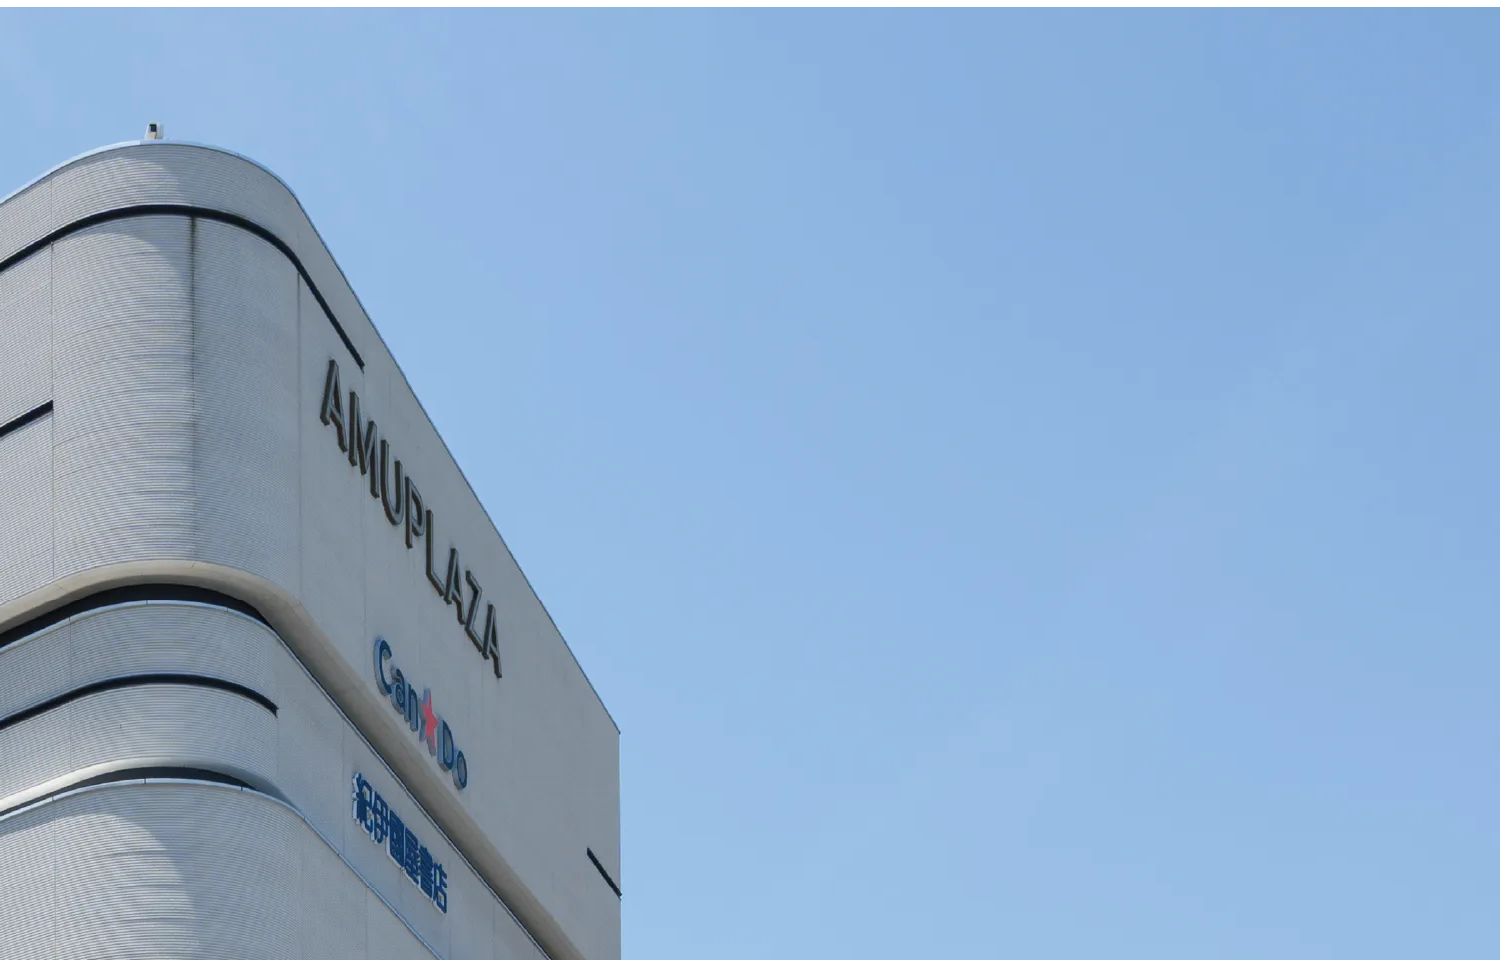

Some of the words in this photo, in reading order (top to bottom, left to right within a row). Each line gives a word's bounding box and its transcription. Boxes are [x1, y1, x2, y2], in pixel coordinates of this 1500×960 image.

[319, 359, 503, 679] AMUPLAZA
[373, 637, 419, 732] Can
[436, 717, 468, 790] Do
[352, 772, 448, 914] 紀伊國屋書店
